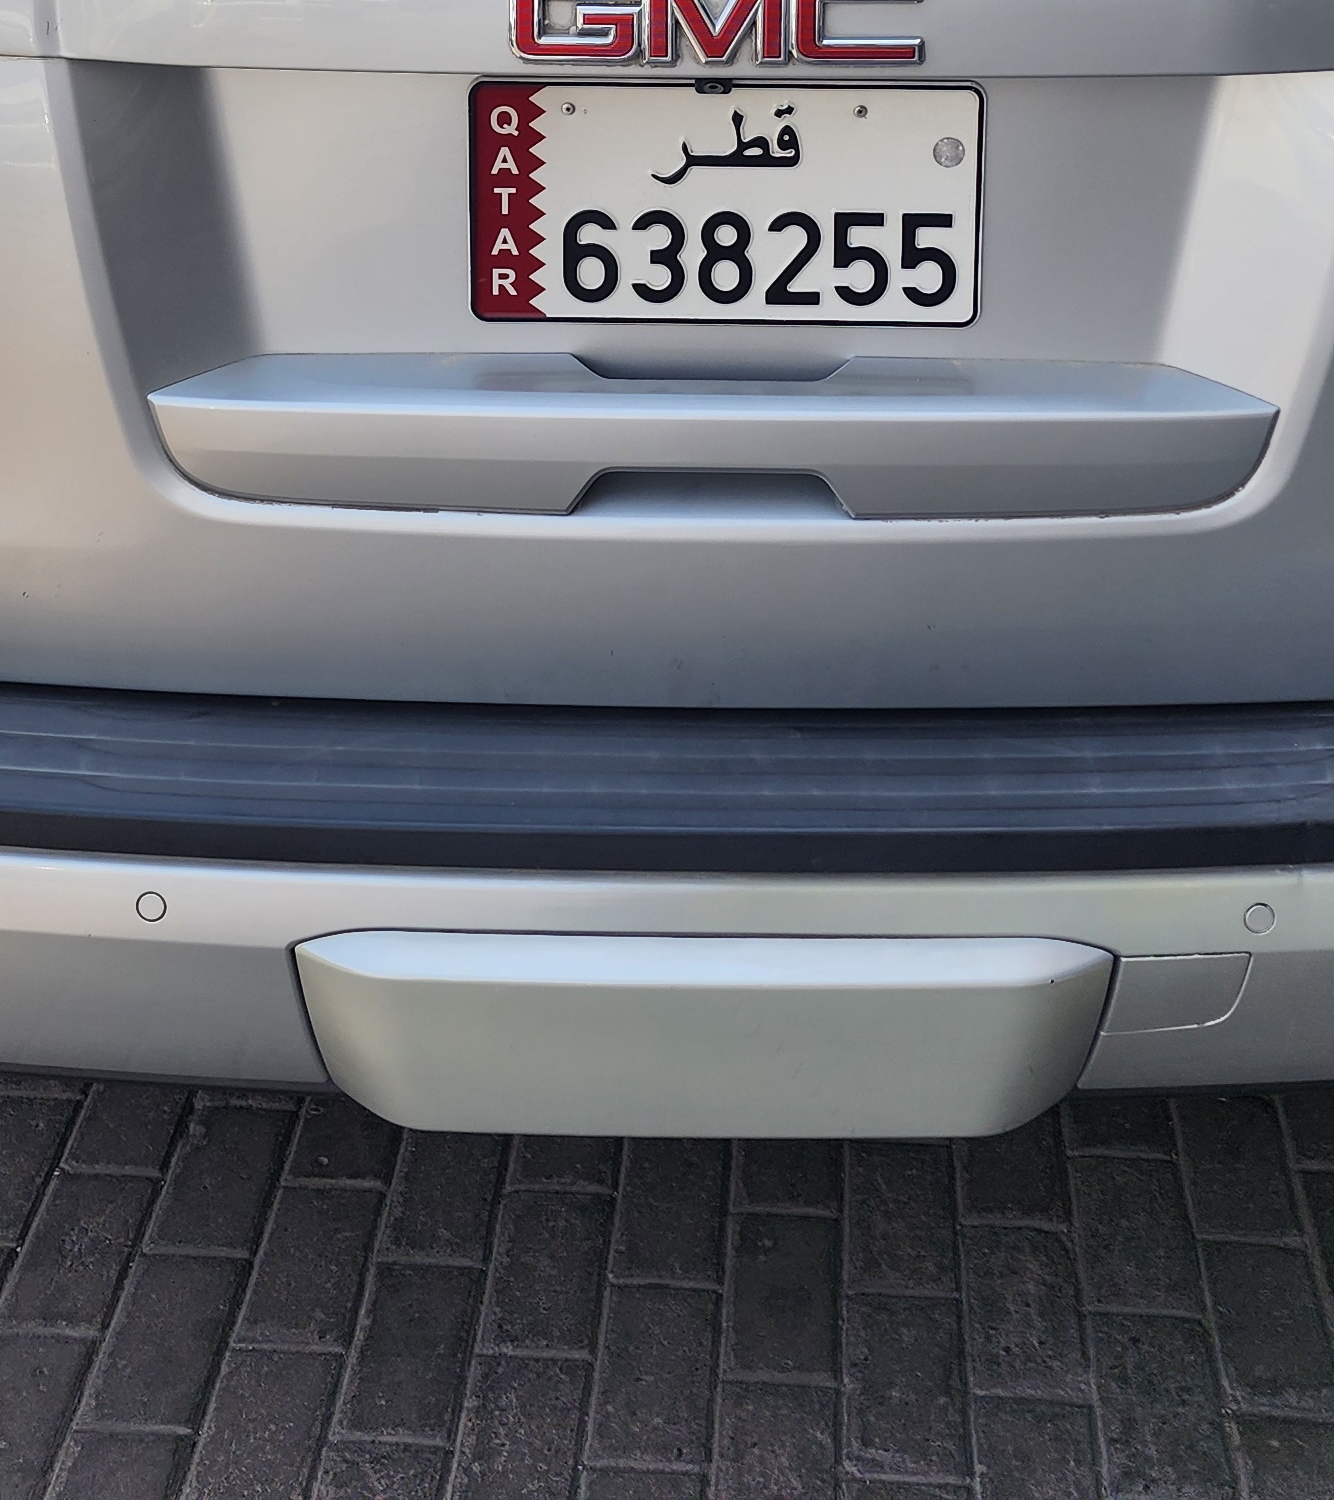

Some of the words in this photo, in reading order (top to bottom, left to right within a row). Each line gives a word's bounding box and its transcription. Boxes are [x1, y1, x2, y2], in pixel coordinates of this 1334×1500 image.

[650, 103, 803, 186] قطر
[490, 104, 521, 297] QATAR
[561, 208, 958, 308] 638255
